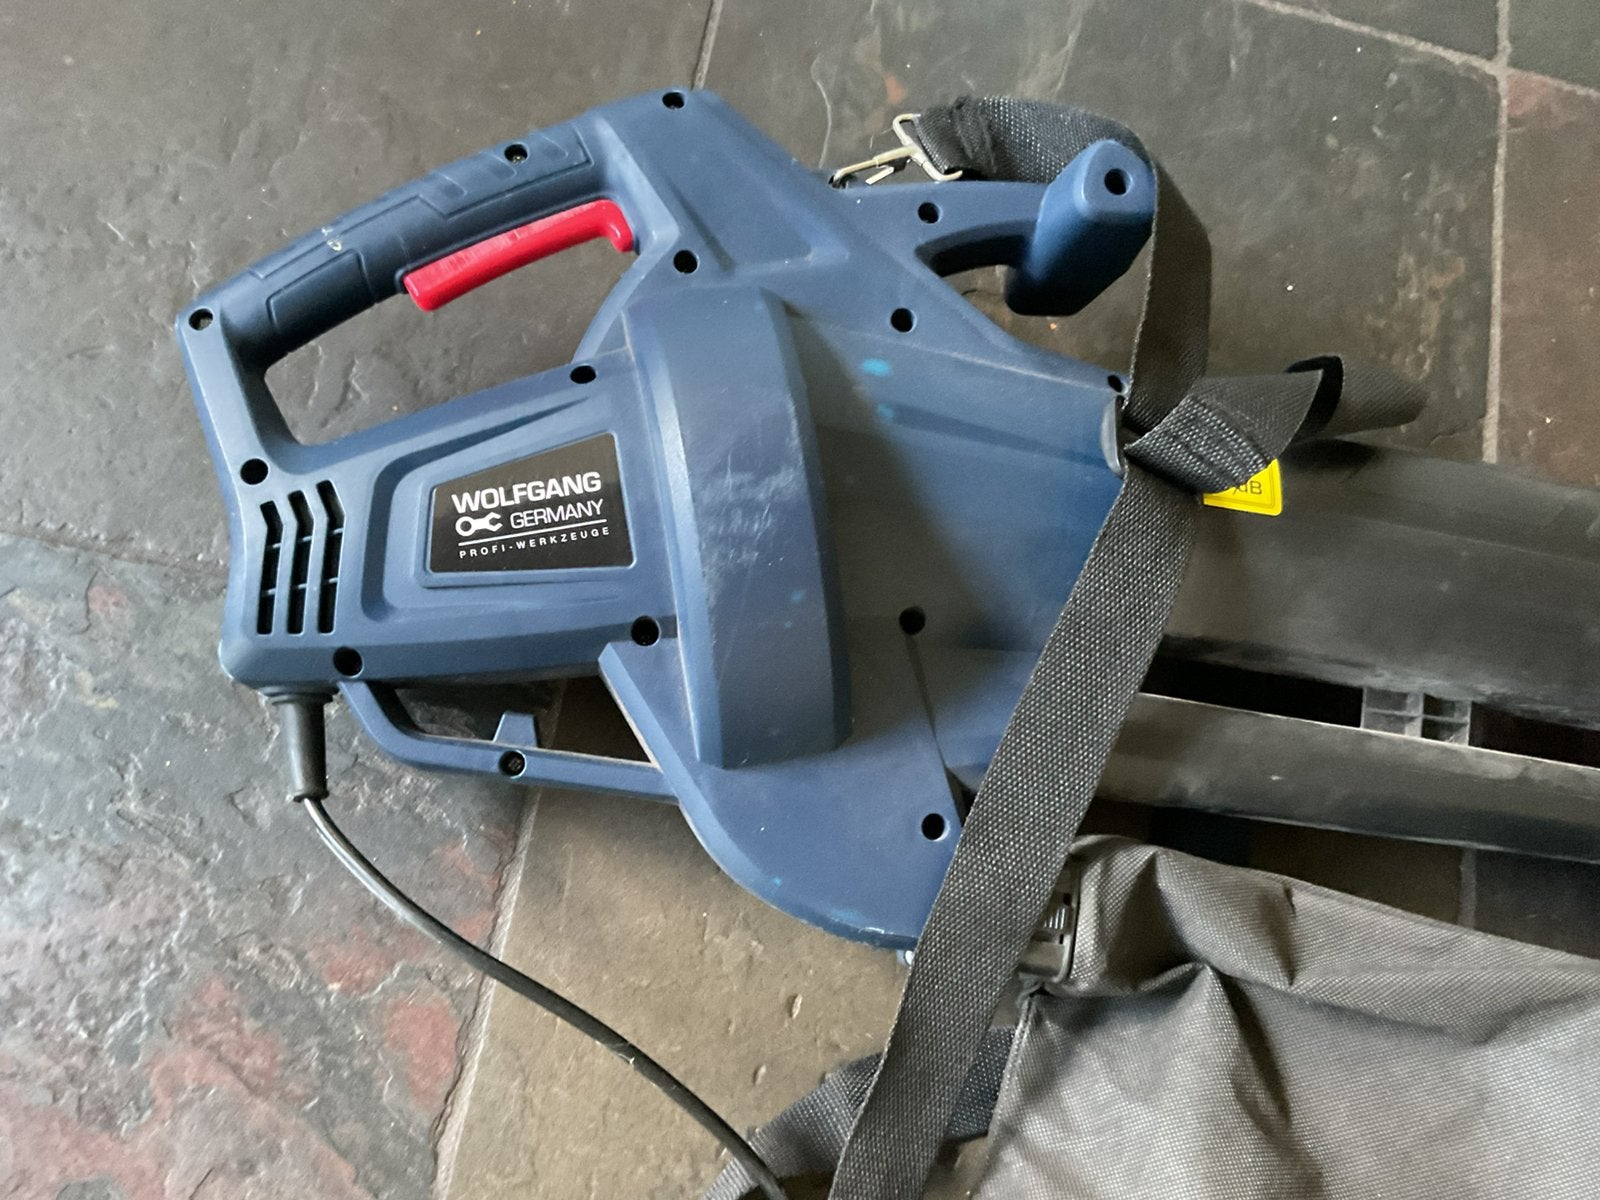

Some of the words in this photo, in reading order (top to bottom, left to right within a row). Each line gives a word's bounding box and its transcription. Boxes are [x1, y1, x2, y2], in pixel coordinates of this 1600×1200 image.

[451, 472, 602, 513] WOLFGANG
[509, 498, 604, 530] GERMANY
[459, 526, 610, 559] PROFI-WERKZEUGE
